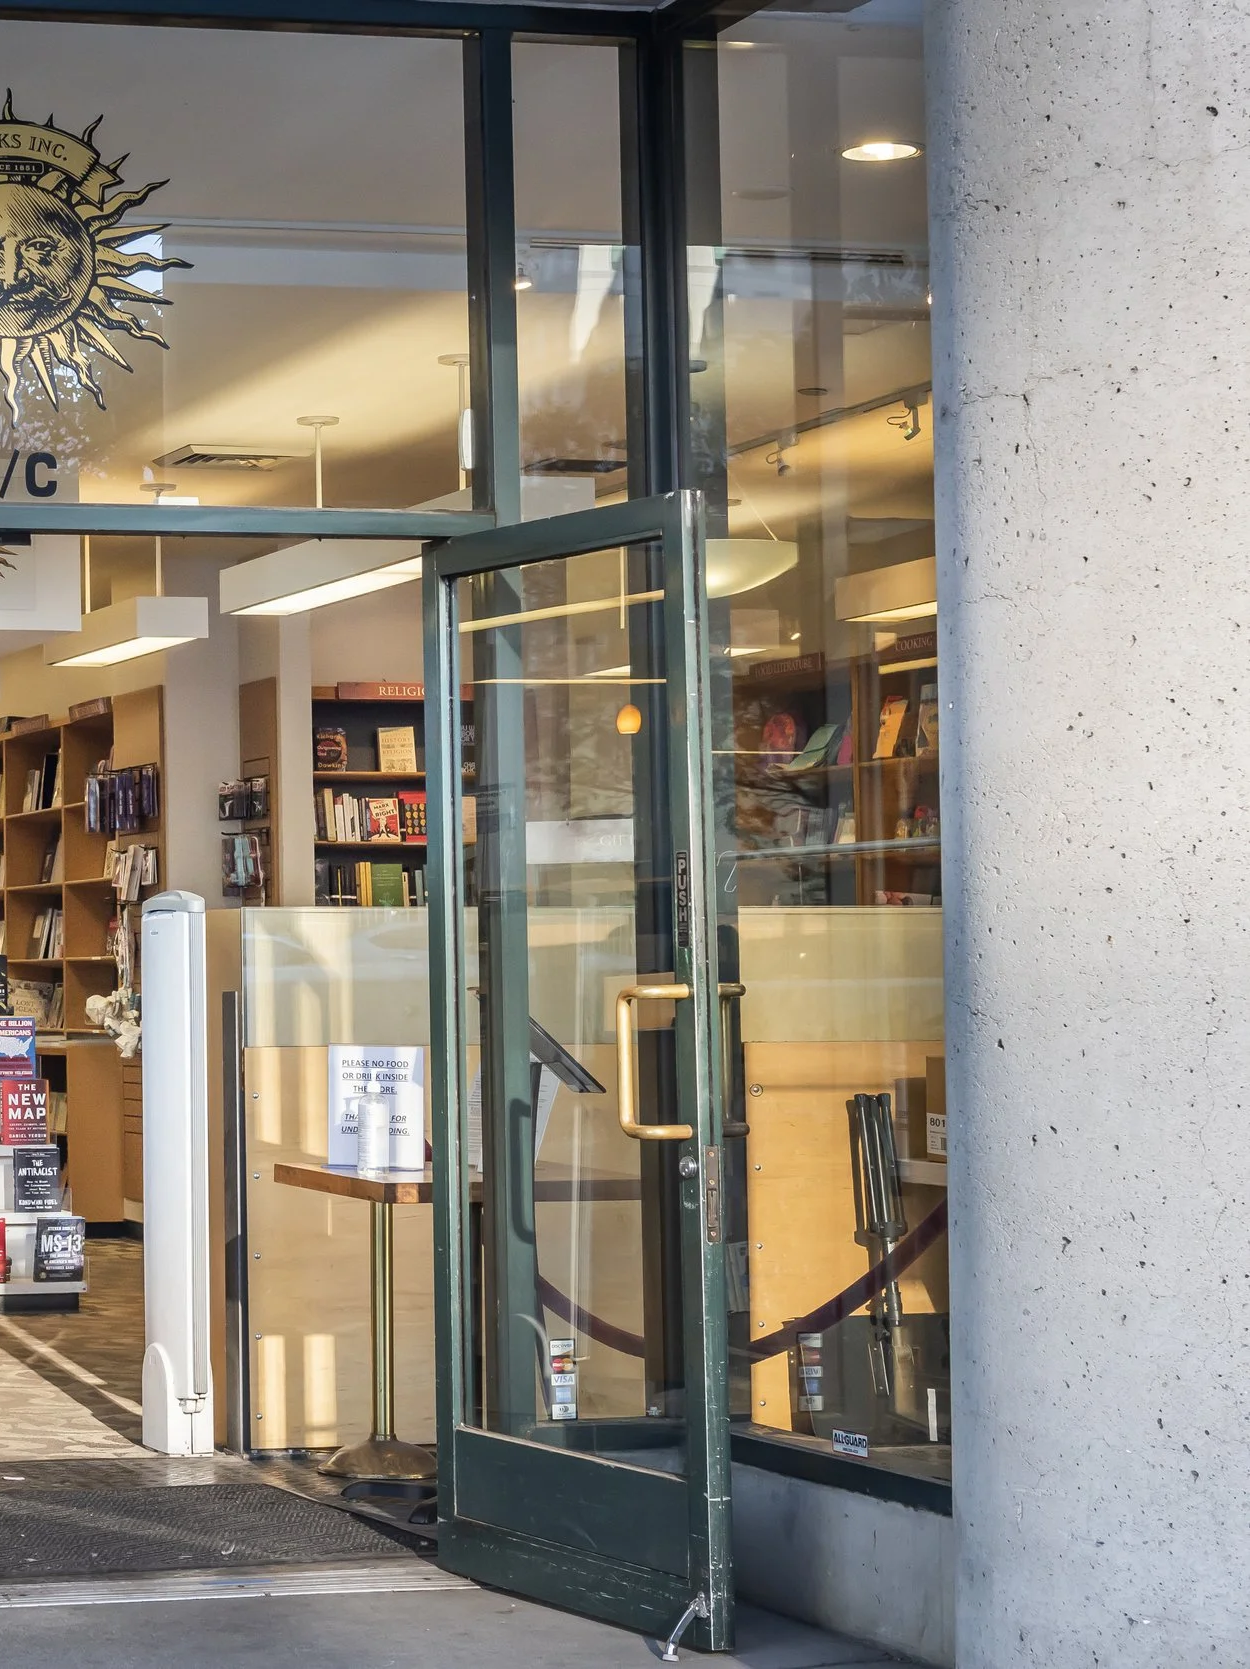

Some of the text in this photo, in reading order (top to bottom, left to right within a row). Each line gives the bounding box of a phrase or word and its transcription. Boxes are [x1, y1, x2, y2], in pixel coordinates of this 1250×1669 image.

[28, 135, 70, 162] INC.
[14, 164, 37, 172] 1851
[896, 635, 933, 652] COOKING
[375, 810, 395, 818] RIGHT
[677, 859, 689, 924] PUSH
[342, 1059, 370, 1068] PLEASE
[386, 1060, 409, 1068] FOOD
[342, 1072, 354, 1080] OR
[384, 1073, 408, 1081] INSIDE
[353, 1085, 397, 1094] THE ORE.
[8, 1093, 46, 1106] NEW
[8, 1108, 46, 1120] MAP
[18, 1167, 58, 1176] ANTIRACIST
[41, 1234, 82, 1252] MS-13
